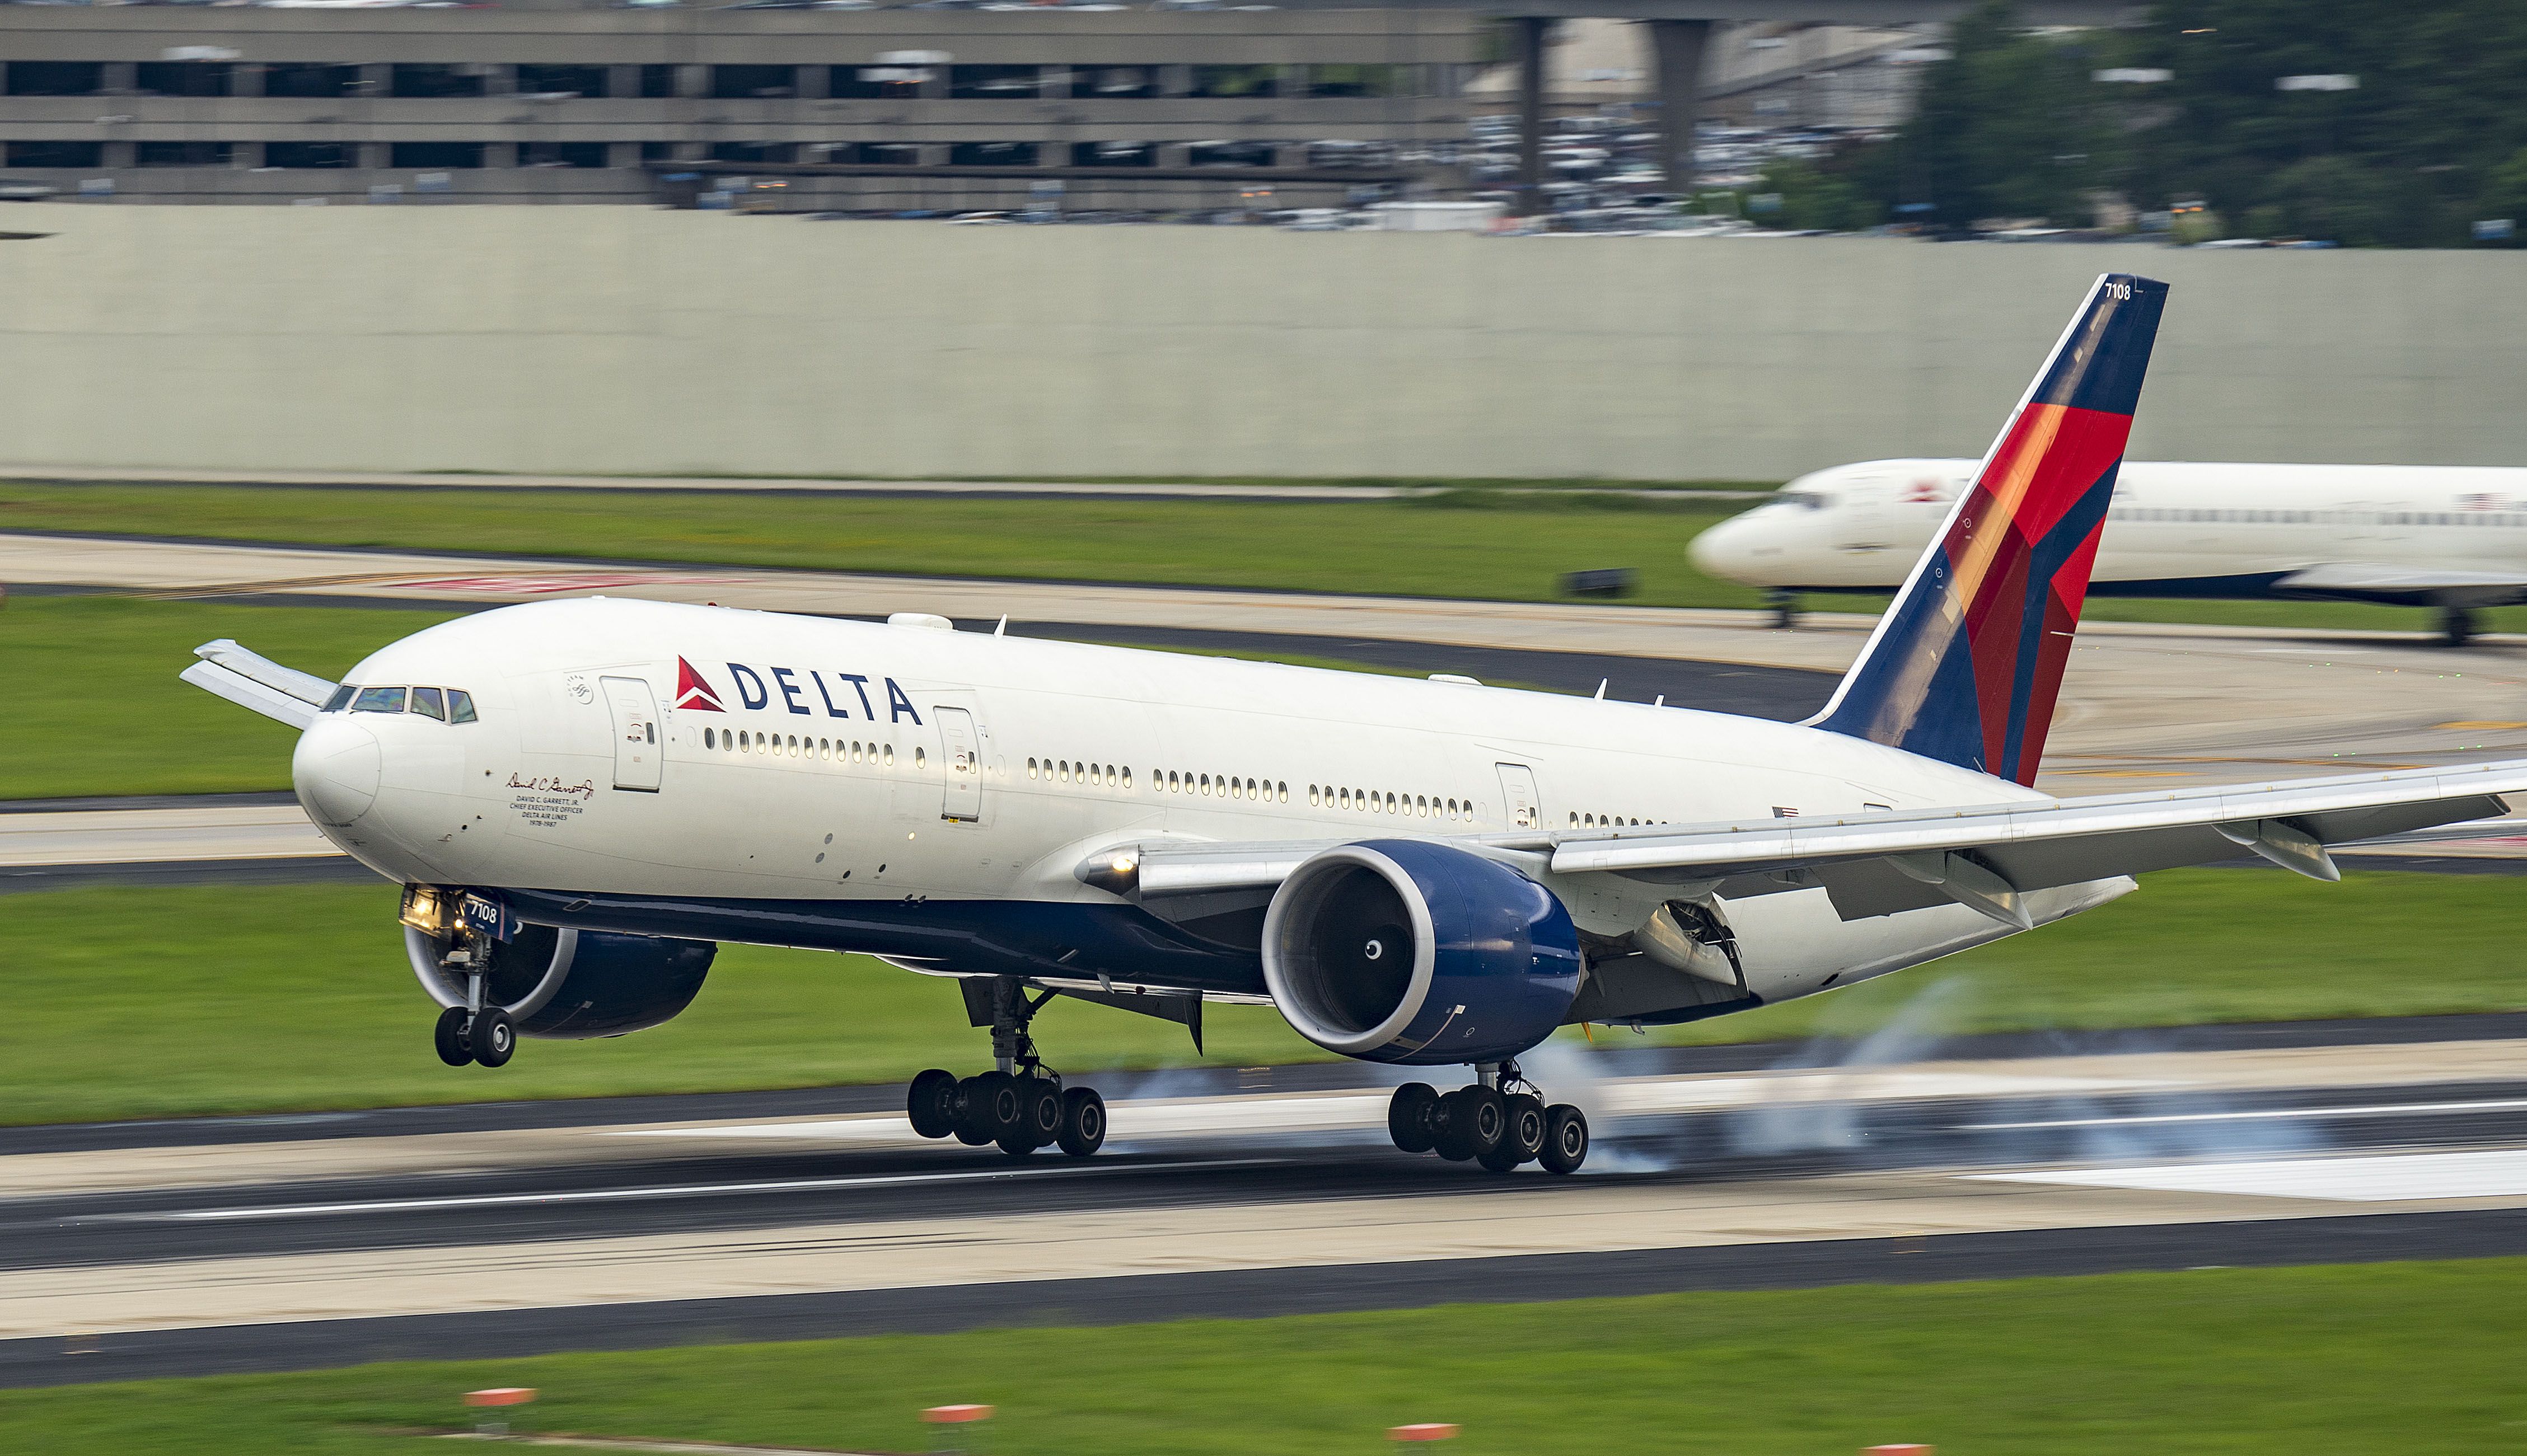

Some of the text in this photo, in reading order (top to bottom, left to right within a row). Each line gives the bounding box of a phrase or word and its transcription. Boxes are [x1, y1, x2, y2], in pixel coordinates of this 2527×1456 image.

[2105, 282, 2131, 301] 7108
[726, 662, 923, 725] DELTA
[539, 778, 547, 790] C
[527, 804, 559, 812] EXECUTIVE
[471, 900, 497, 923] 7108
